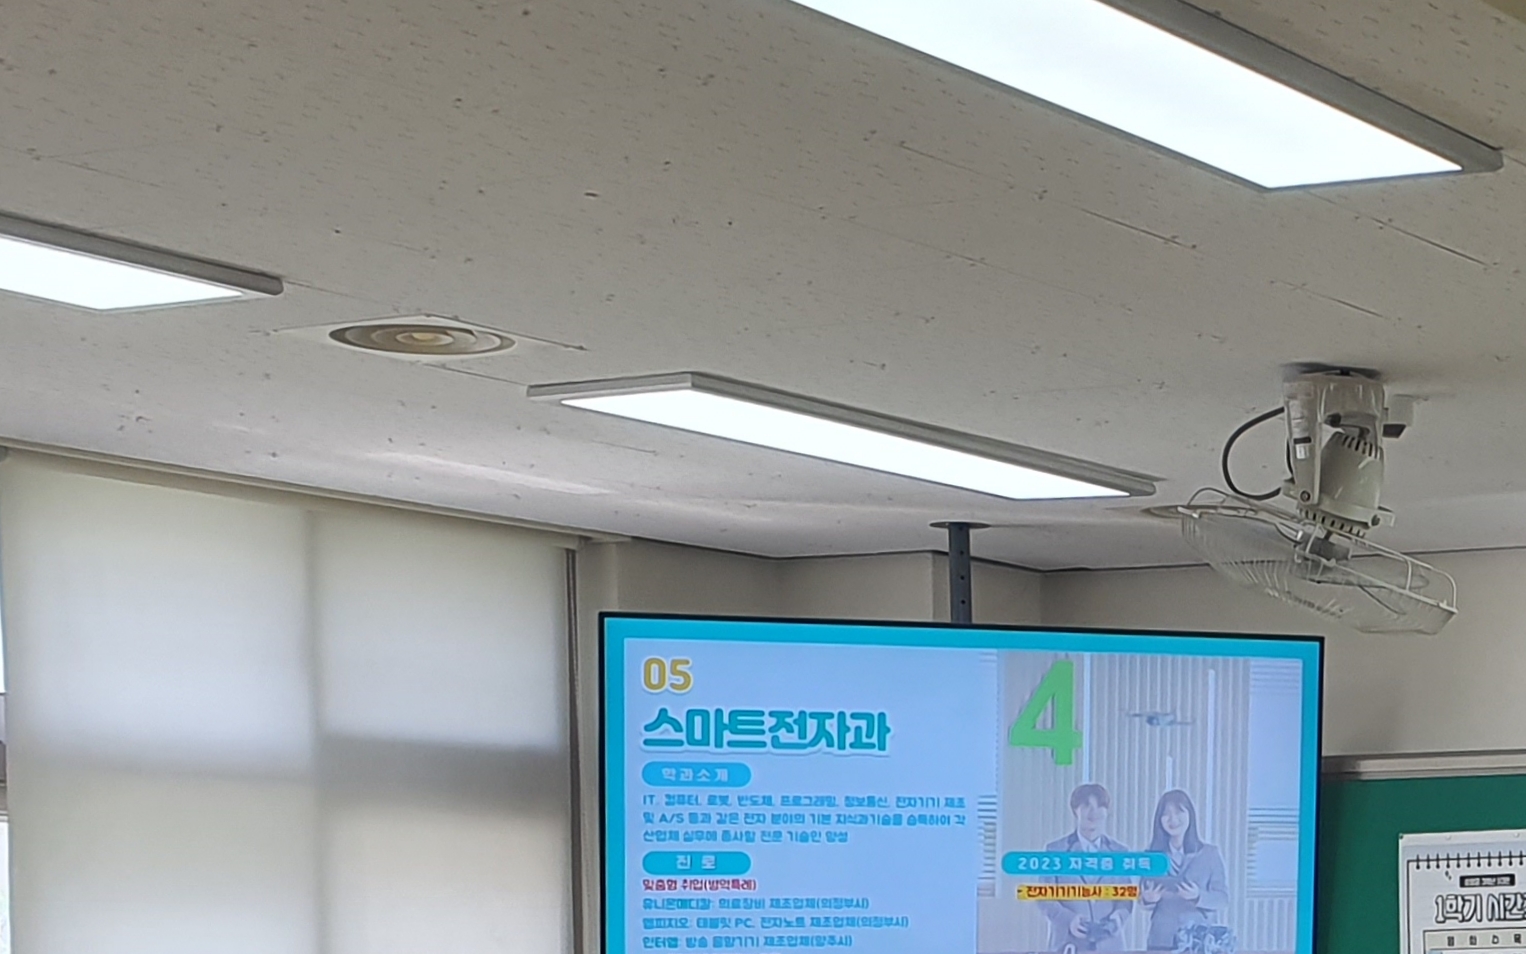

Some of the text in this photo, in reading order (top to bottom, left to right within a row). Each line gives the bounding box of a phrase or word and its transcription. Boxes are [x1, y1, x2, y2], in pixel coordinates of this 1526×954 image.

[642, 657, 693, 692] 05
[1008, 659, 1083, 766] 4
[642, 707, 892, 752] 스마트전자과
[661, 767, 729, 783] 학과소개
[659, 811, 685, 824] A/S
[744, 812, 767, 825] 전자
[1017, 856, 1152, 871] 2023 자격증 취득
[642, 878, 678, 891] 맞춤형
[1435, 893, 1483, 924] 1학기
